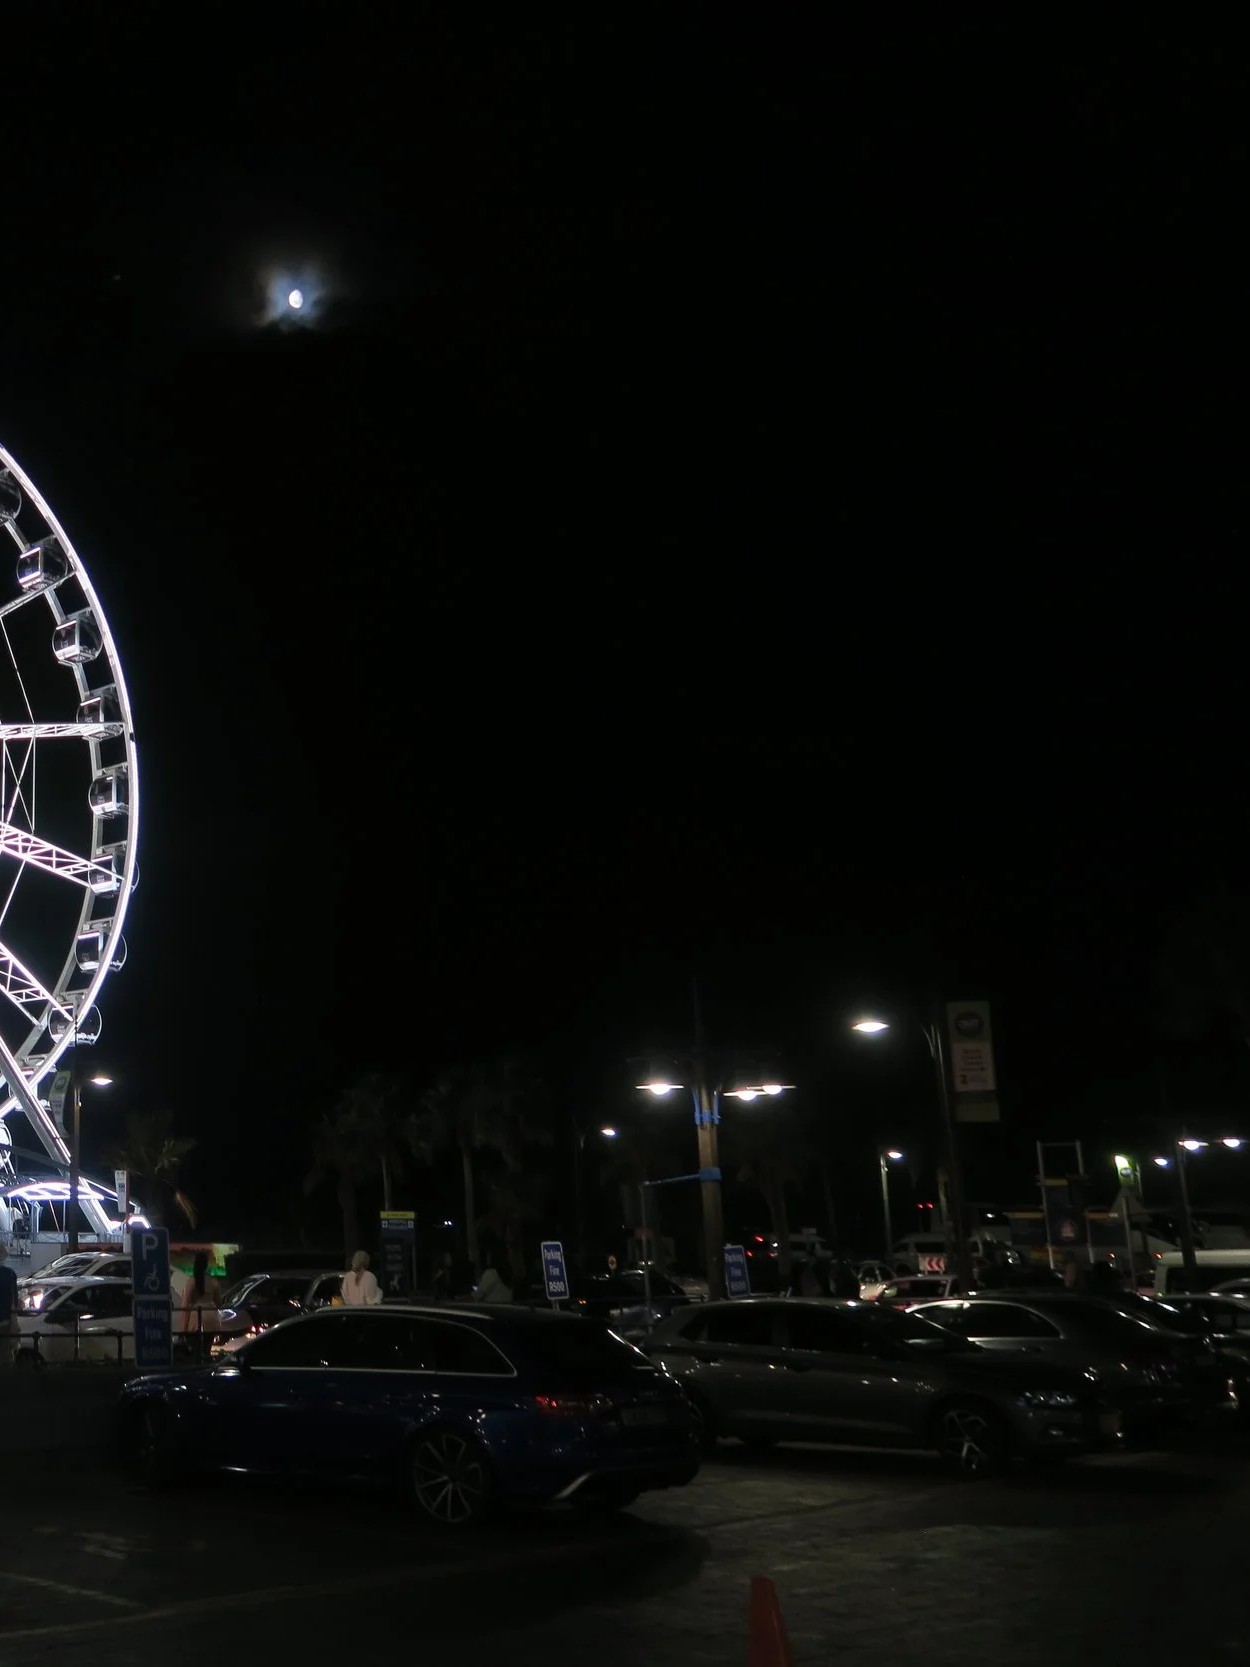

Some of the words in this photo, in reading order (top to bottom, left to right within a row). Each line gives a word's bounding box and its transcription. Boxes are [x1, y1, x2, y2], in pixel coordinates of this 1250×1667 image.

[142, 1232, 159, 1261] P
[543, 1249, 562, 1263] Parking
[137, 1304, 169, 1322] Parking
